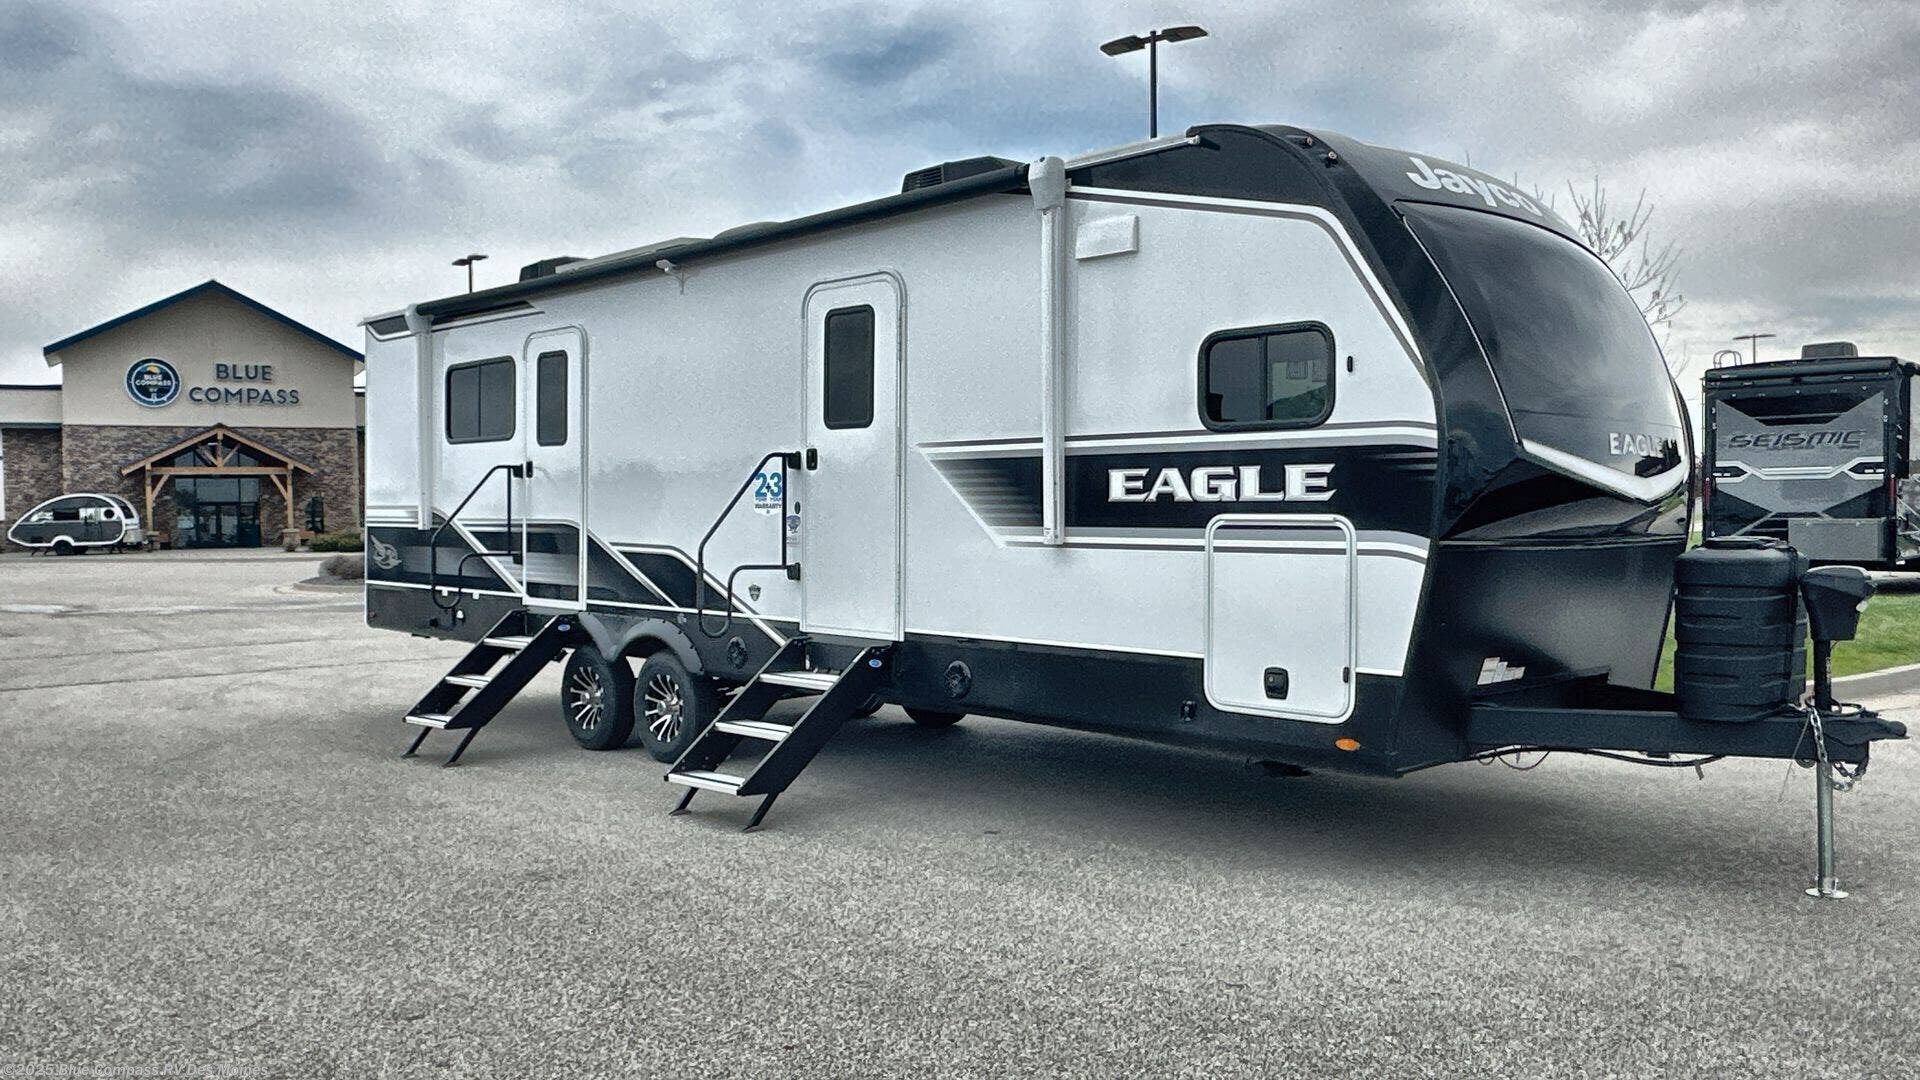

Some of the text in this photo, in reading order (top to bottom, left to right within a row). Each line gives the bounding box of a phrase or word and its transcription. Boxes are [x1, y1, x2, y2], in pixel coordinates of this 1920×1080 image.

[1406, 157, 1543, 217] Jayco
[216, 364, 273, 380] BLUE
[189, 387, 300, 404] COMPASS
[1609, 432, 1665, 458] EAGLE
[1728, 430, 1866, 450] SEISMIC
[1107, 463, 1336, 502] EAGLE
